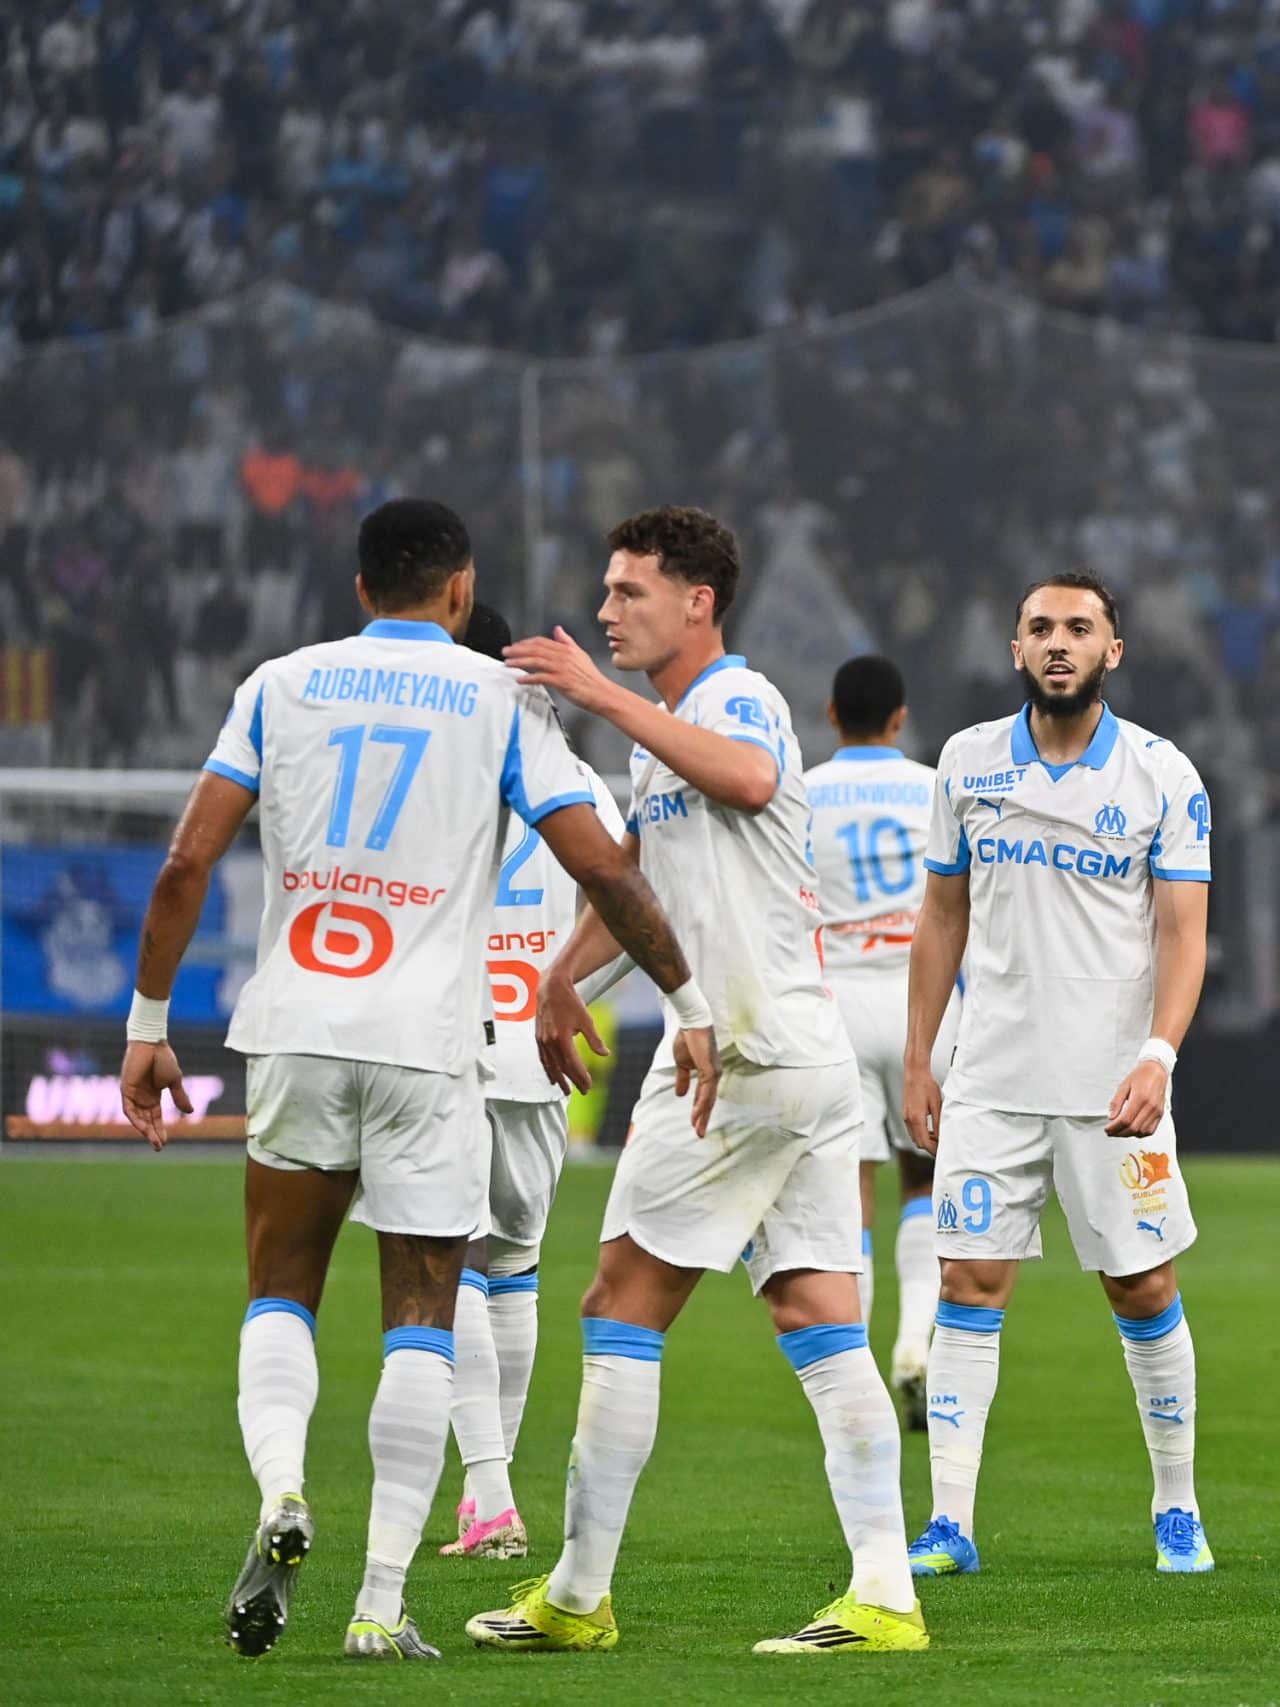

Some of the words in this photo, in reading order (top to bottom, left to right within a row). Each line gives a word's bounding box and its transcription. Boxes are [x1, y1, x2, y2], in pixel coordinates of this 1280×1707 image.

[303, 668, 479, 717] AUBAMEYANG
[326, 723, 432, 851] 17
[963, 768, 1027, 790] UNIBET
[835, 816, 916, 904] 10
[977, 838, 1048, 866] CMA
[1052, 844, 1131, 879] CGM
[283, 866, 446, 907] boulanger
[962, 1178, 992, 1234] 9
